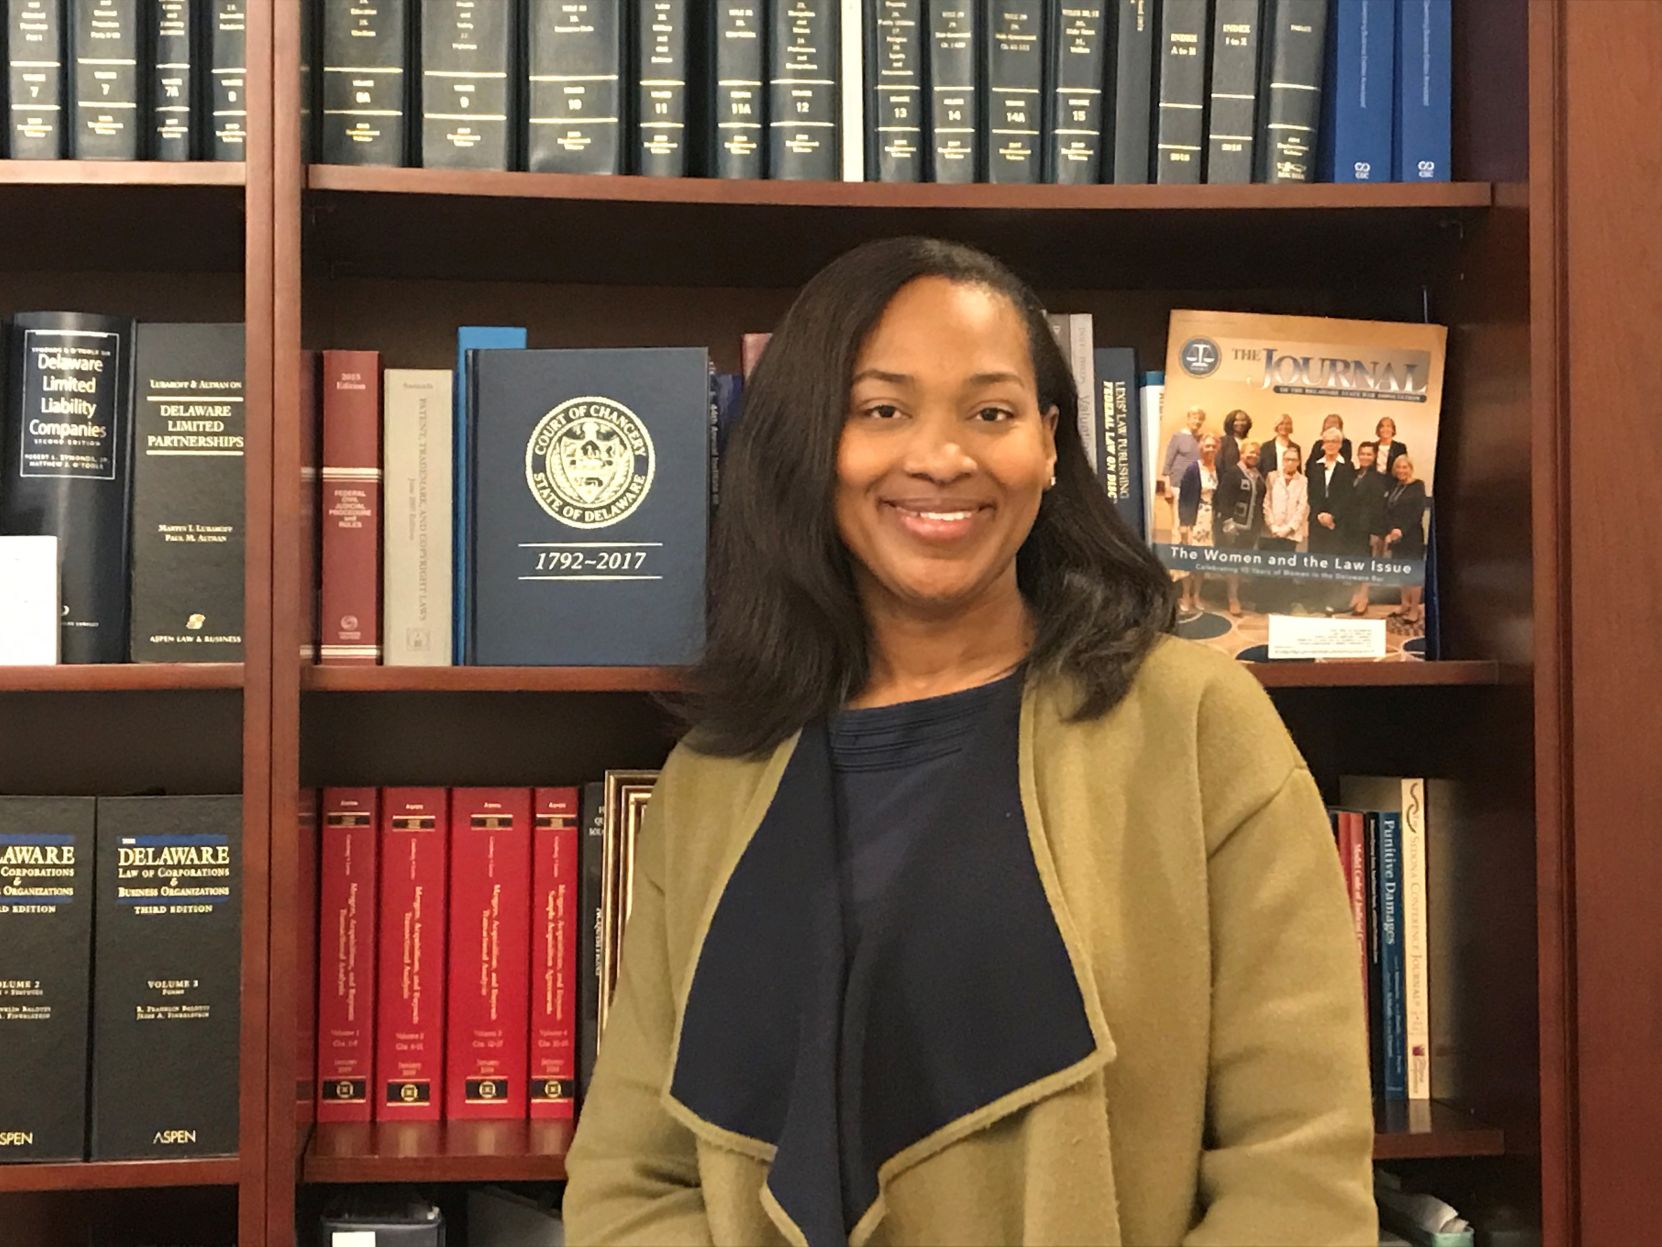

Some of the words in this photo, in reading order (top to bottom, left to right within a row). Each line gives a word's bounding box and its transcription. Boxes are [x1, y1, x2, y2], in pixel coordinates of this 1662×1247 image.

[1171, 46, 1178, 56] A
[654, 103, 668, 114] 11
[731, 103, 752, 115] 11A
[796, 102, 810, 113] 12
[894, 108, 907, 118] 13
[948, 110, 962, 120] 14
[1006, 112, 1026, 122] 14A
[1072, 110, 1086, 121] 15
[38, 353, 104, 372] Delaware
[1232, 348, 1261, 362] THE
[1261, 348, 1428, 393] JOURNAL
[42, 376, 96, 393] Limited
[41, 398, 96, 418] Liability
[160, 405, 232, 417] DELAWARE
[1104, 381, 1115, 429] FEDERAL
[29, 419, 106, 440] Companies
[168, 420, 224, 432] LIMITED
[534, 413, 566, 456] COURT
[568, 405, 587, 418] OF
[590, 404, 646, 457] CHANCERY
[1116, 414, 1128, 436] LAW
[147, 435, 244, 448] PARTNERSHIPS
[1105, 432, 1116, 454] LAW
[1106, 456, 1116, 472] ON
[1118, 438, 1130, 498] PUBLISHING
[533, 472, 561, 510] STATE
[562, 505, 584, 520] OF
[584, 474, 646, 522] DELAWARE
[418, 510, 428, 531] AND
[418, 534, 428, 592] COPYRIGHT
[1171, 547, 1198, 561] The
[1204, 548, 1262, 564] Women
[1268, 554, 1297, 567] and
[1303, 556, 1328, 569] the
[1335, 559, 1365, 572] Law
[1372, 560, 1412, 574] Issue
[1196, 563, 1238, 574] Celebrating
[418, 595, 428, 622] LAWS
[118, 846, 230, 866] DELAWARE
[1384, 820, 1396, 879] Punitive
[1, 867, 74, 877] CORPORATIONS
[118, 868, 138, 878] LAW
[142, 868, 154, 878] OF
[158, 867, 230, 877] CORPORATIONS
[13, 877, 21, 886] &
[170, 877, 178, 886] &
[4, 887, 73, 897] ORGANIZATIONS
[118, 888, 158, 897] BUSINESS
[161, 886, 230, 896] ORGANIZATIONS
[12, 905, 56, 913] EDITION
[134, 905, 166, 914] THIRD
[170, 905, 212, 914] EDITION
[1384, 882, 1396, 944] Damages
[1411, 882, 1421, 952] CONFERENCE
[148, 980, 190, 989] VOLUME
[153, 1130, 196, 1144] ASPEN
